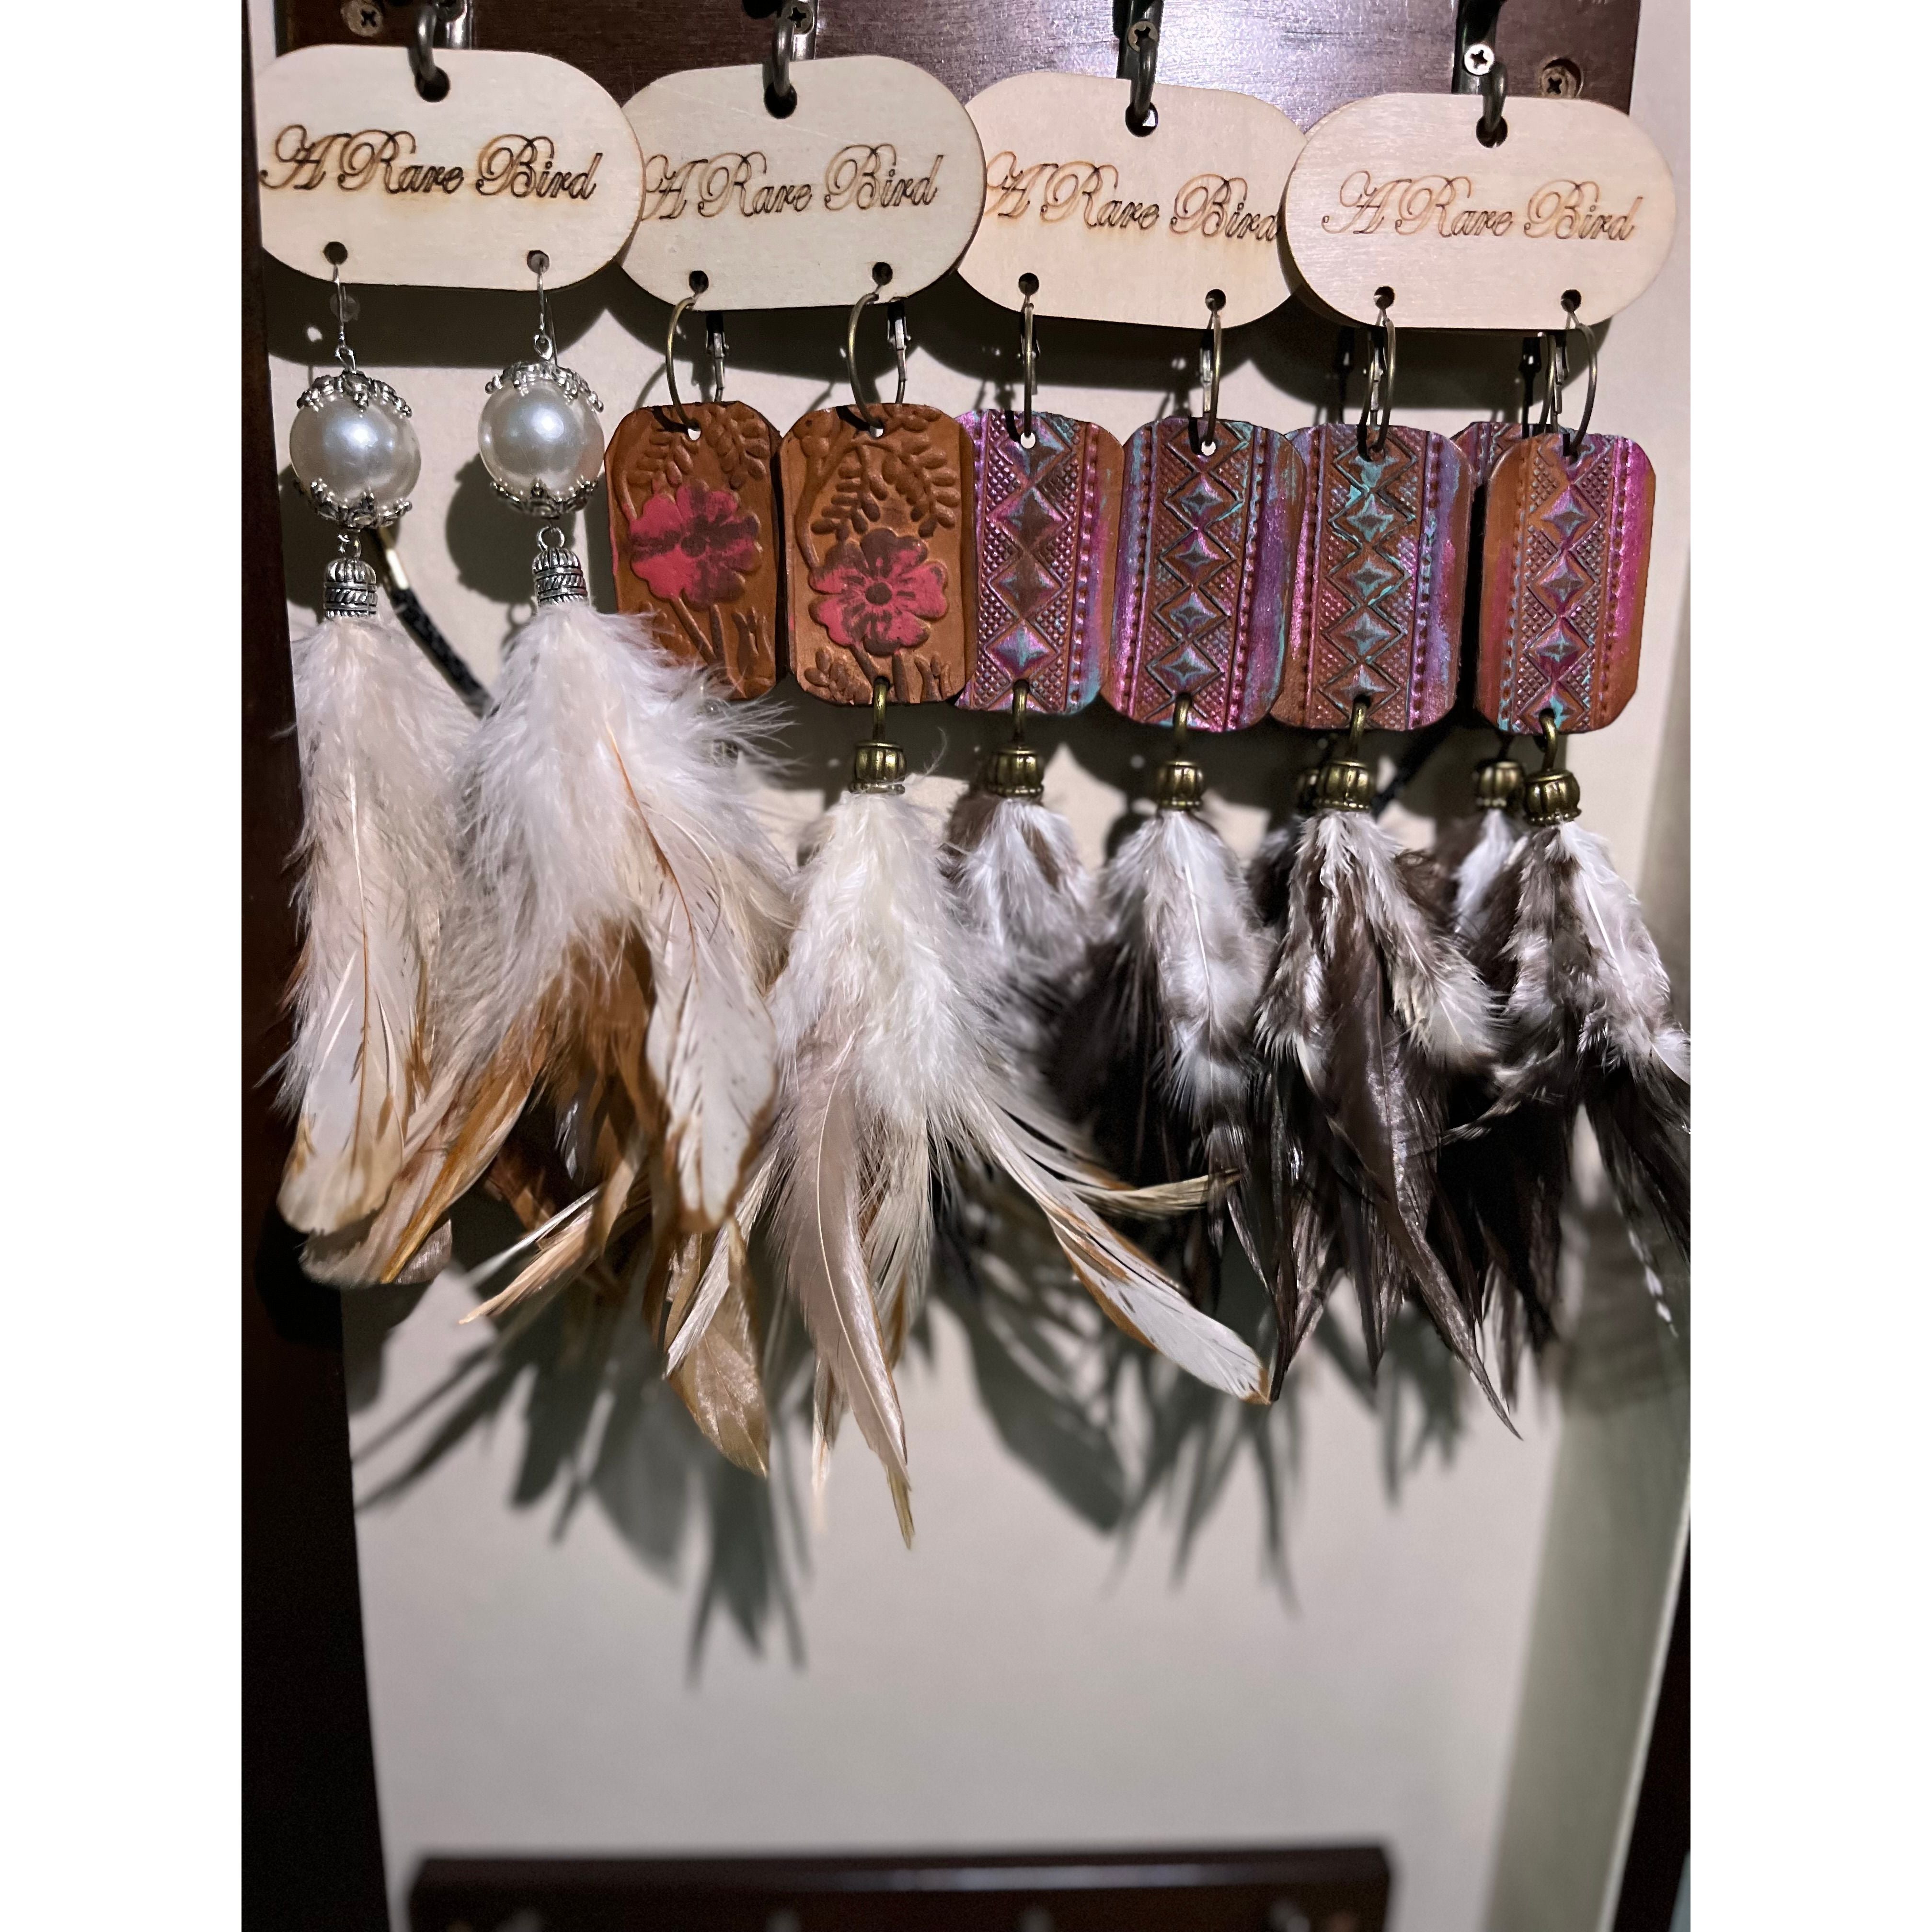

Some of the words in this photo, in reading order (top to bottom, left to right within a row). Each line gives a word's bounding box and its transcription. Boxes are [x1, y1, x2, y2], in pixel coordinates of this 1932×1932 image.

[259, 124, 352, 190] A
[337, 129, 464, 195] Rare
[476, 134, 604, 199] Bird
[641, 154, 708, 220] A
[698, 151, 812, 218] Rare
[823, 143, 944, 211] Bird
[985, 150, 1059, 218] A
[1039, 161, 1160, 230] Rare
[1321, 170, 1412, 235] A
[1394, 175, 1514, 238] Rare
[1523, 179, 1644, 240] Bird
